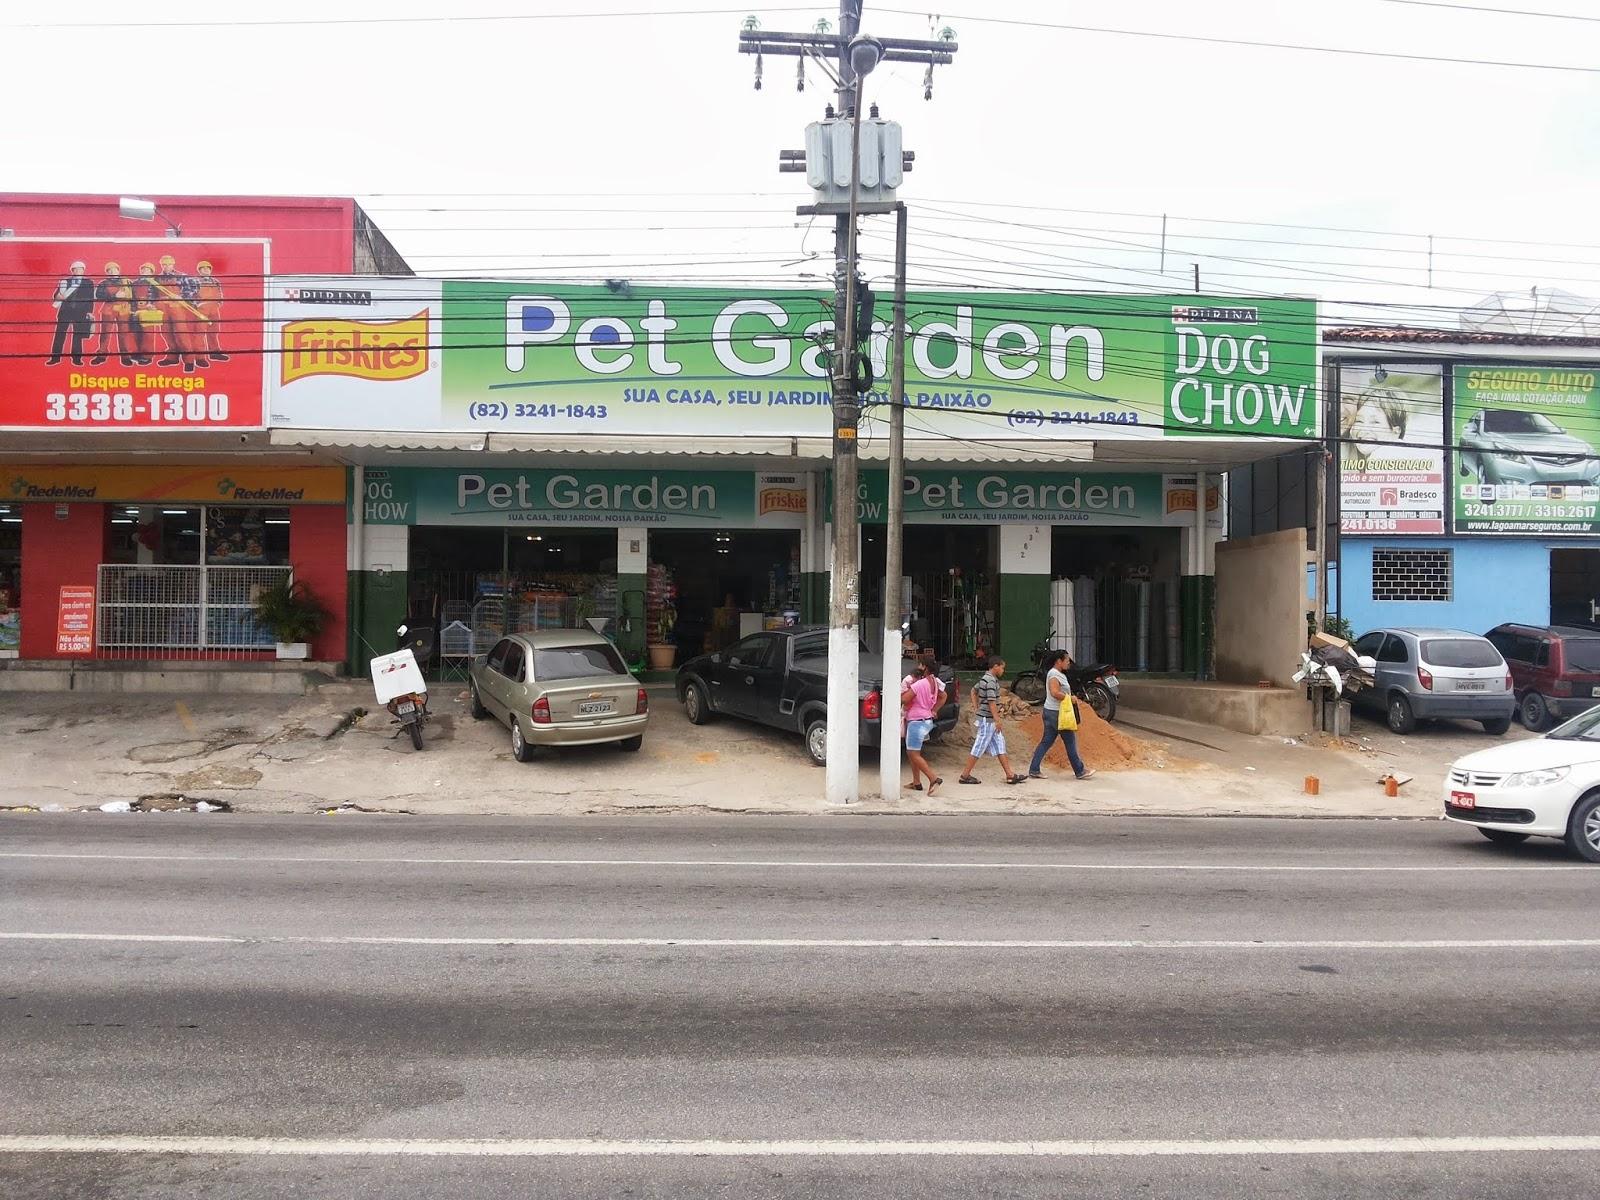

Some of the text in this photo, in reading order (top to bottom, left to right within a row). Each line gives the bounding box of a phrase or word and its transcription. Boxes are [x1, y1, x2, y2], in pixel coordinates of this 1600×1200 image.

[302, 290, 368, 304] PURINA
[1189, 309, 1253, 321] PURINA
[505, 295, 1105, 382] Pet Garden
[291, 328, 420, 370] Friskies
[1174, 327, 1270, 375] DOG
[69, 374, 206, 391] Disque Entrega
[1467, 370, 1595, 393] SEGURO AUTO
[624, 388, 660, 403] SUA
[666, 389, 722, 406] CASA,
[728, 390, 762, 405] SEU
[917, 390, 992, 408] PAIXÃO
[1171, 378, 1308, 426] CHOW
[1475, 391, 1588, 405] FAÇA UMA COTAÇÃO AQUI
[46, 393, 229, 421] 3338-1300
[468, 402, 608, 420] (82) 3241-1843
[1007, 409, 1138, 427] (82) 3241-1843
[1366, 459, 1434, 470] CONSIGNADO
[1341, 473, 1361, 483] pido
[1386, 474, 1428, 483] burocracia
[26, 484, 97, 498] RedeMed
[233, 486, 304, 500] RedeMed
[363, 482, 393, 500] OG
[457, 474, 717, 510] Pet Garden
[976, 475, 1136, 510] Garden
[1400, 490, 1438, 499] Bradesco
[765, 493, 807, 508] Friskie
[353, 502, 409, 520] HOW
[605, 514, 632, 522] NOSSA
[634, 513, 667, 522] PAIXÃO
[1032, 513, 1056, 521] NOSSA
[1058, 512, 1090, 521] PAIXÃO
[1464, 503, 1524, 517] 3241.3777
[1535, 505, 1597, 518] 3316.2617
[1467, 520, 1593, 532] www.lagoamarseguros.com.br
